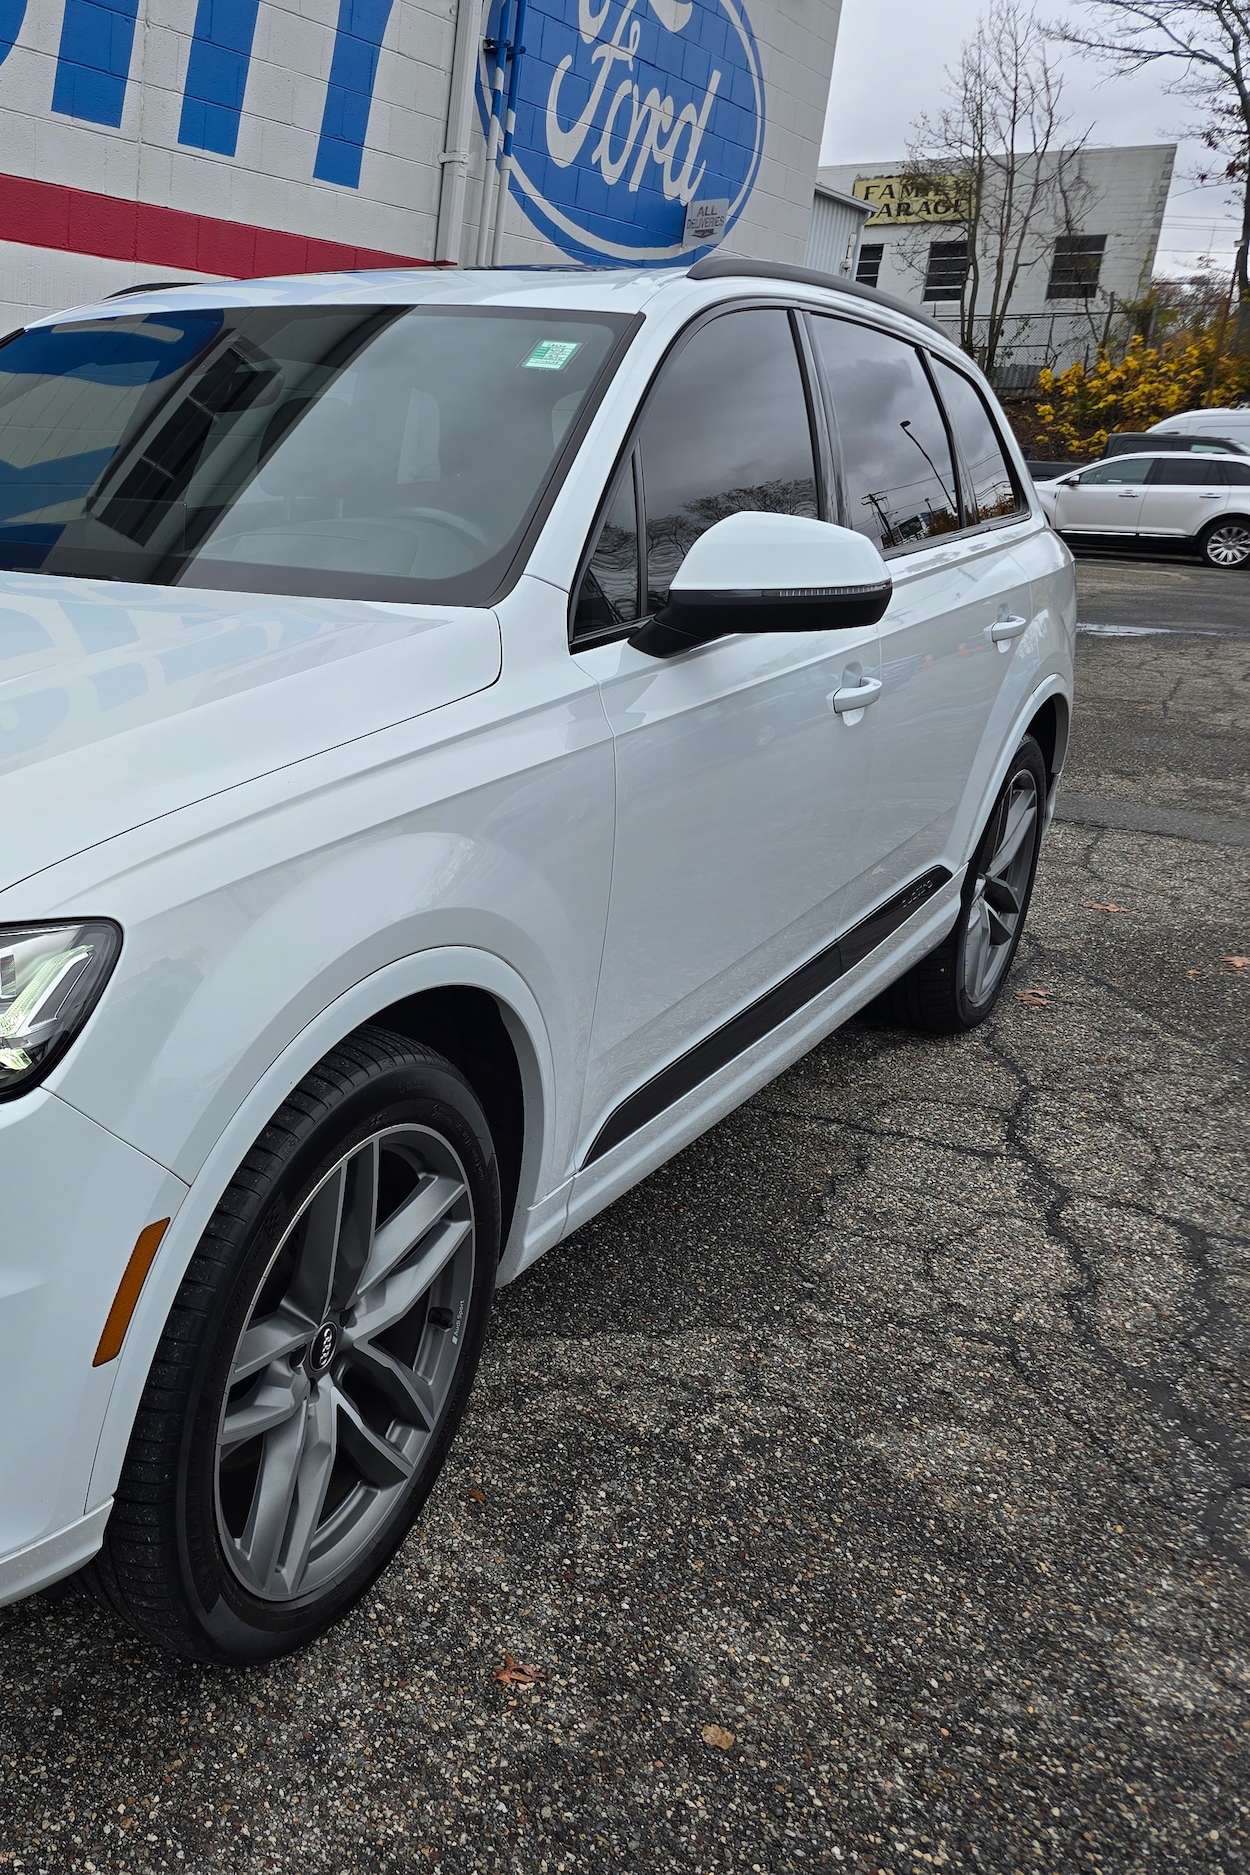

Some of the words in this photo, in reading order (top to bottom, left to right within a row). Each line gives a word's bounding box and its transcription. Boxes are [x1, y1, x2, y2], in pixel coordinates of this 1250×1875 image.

[546, 0, 721, 206] Ford
[863, 179, 969, 200] FAM
[697, 205, 717, 217] ALL
[869, 199, 968, 219] ARAGE
[686, 215, 726, 229] DELIVERIES
[456, 1299, 464, 1320] Sport
[453, 1320, 461, 1336] Audi
